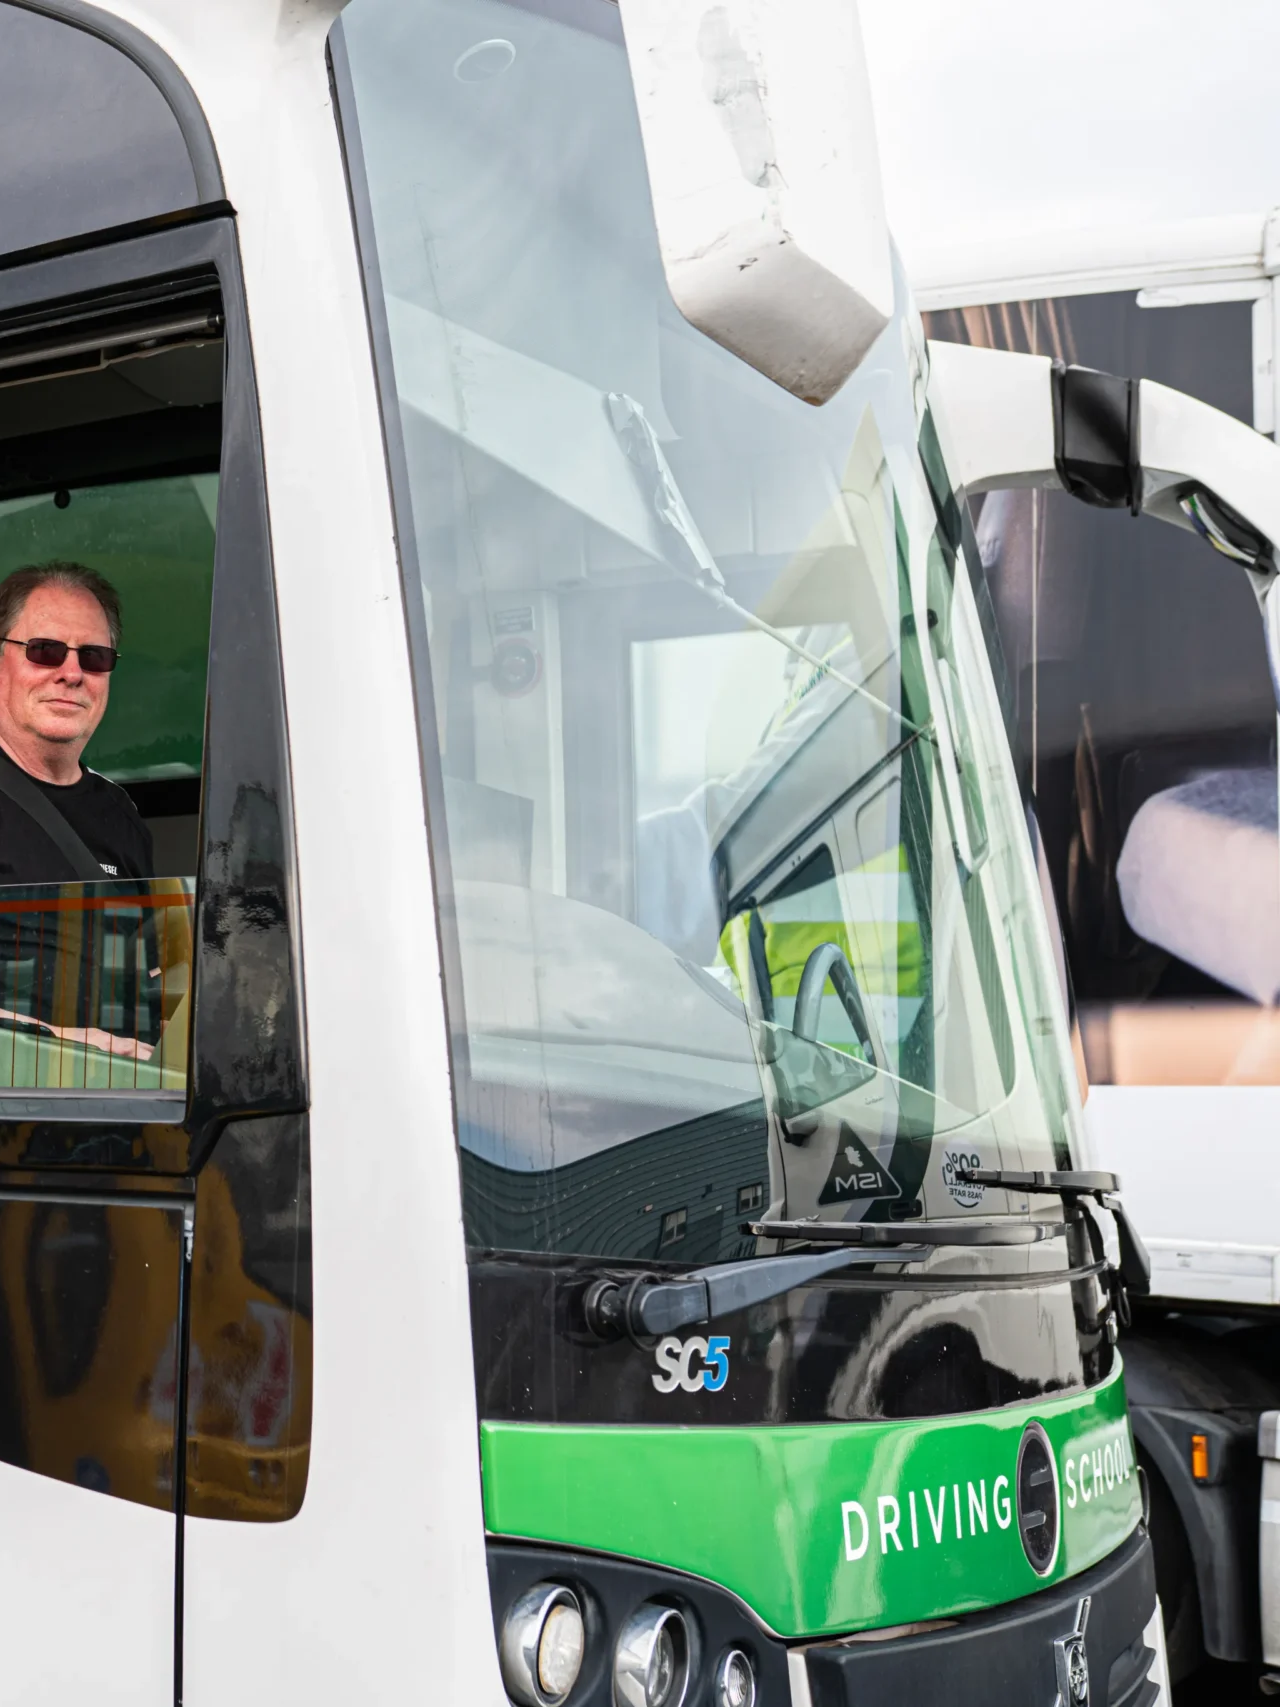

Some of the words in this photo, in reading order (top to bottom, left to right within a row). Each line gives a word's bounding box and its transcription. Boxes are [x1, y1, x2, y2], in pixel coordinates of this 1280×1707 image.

[651, 1336, 731, 1393] SC5
[841, 1475, 1012, 1562] DRIVING
[1065, 1436, 1130, 1508] SCHOOL
